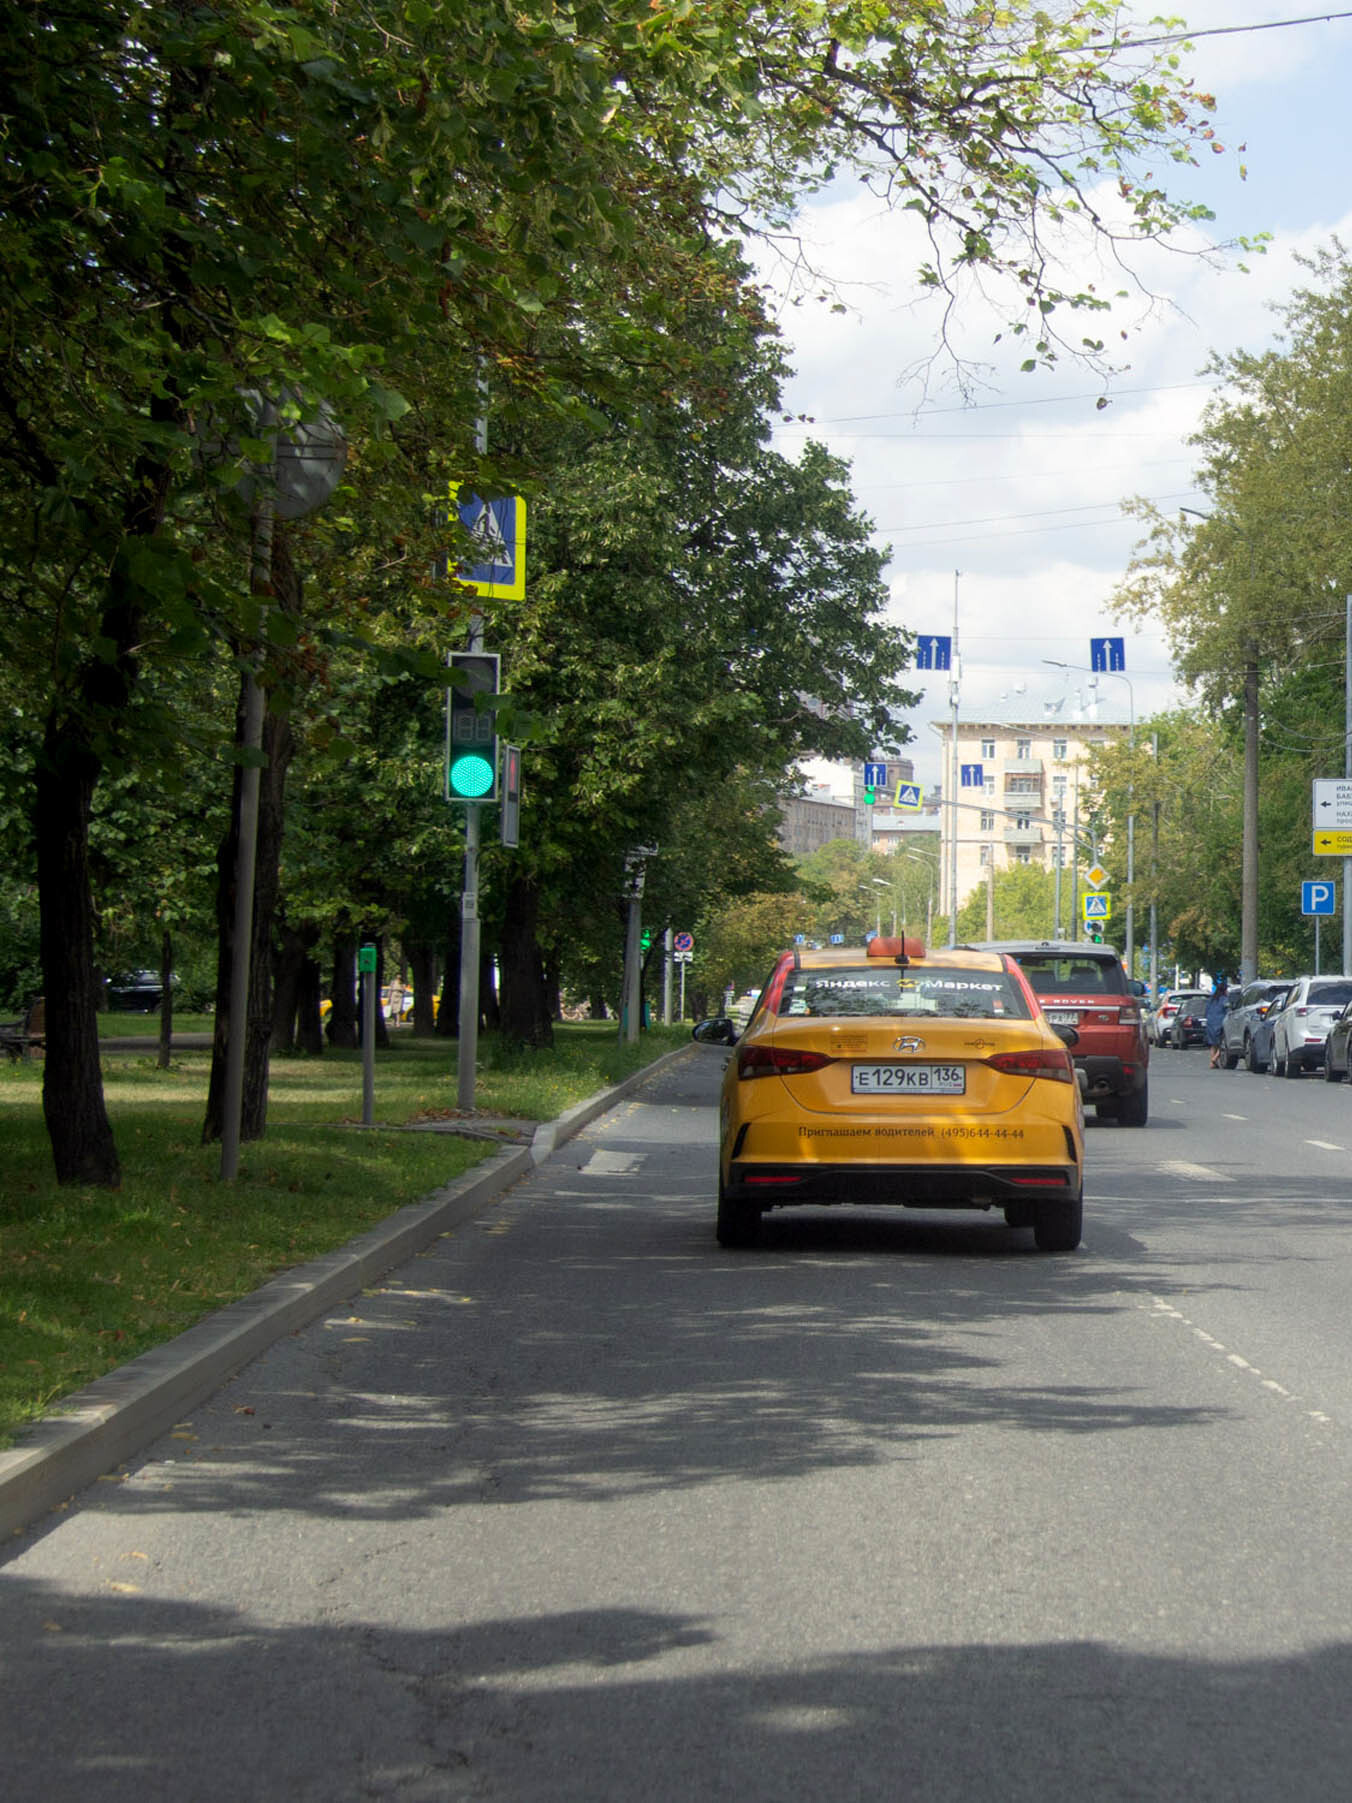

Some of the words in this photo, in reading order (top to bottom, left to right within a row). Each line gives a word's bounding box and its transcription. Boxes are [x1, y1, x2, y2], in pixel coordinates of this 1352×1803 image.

[815, 979, 891, 989] Яндекс
[925, 979, 1004, 991] Маркет
[933, 1067, 960, 1082] 136
[798, 1126, 871, 1139] Приглашаем
[874, 1126, 934, 1138] водителей
